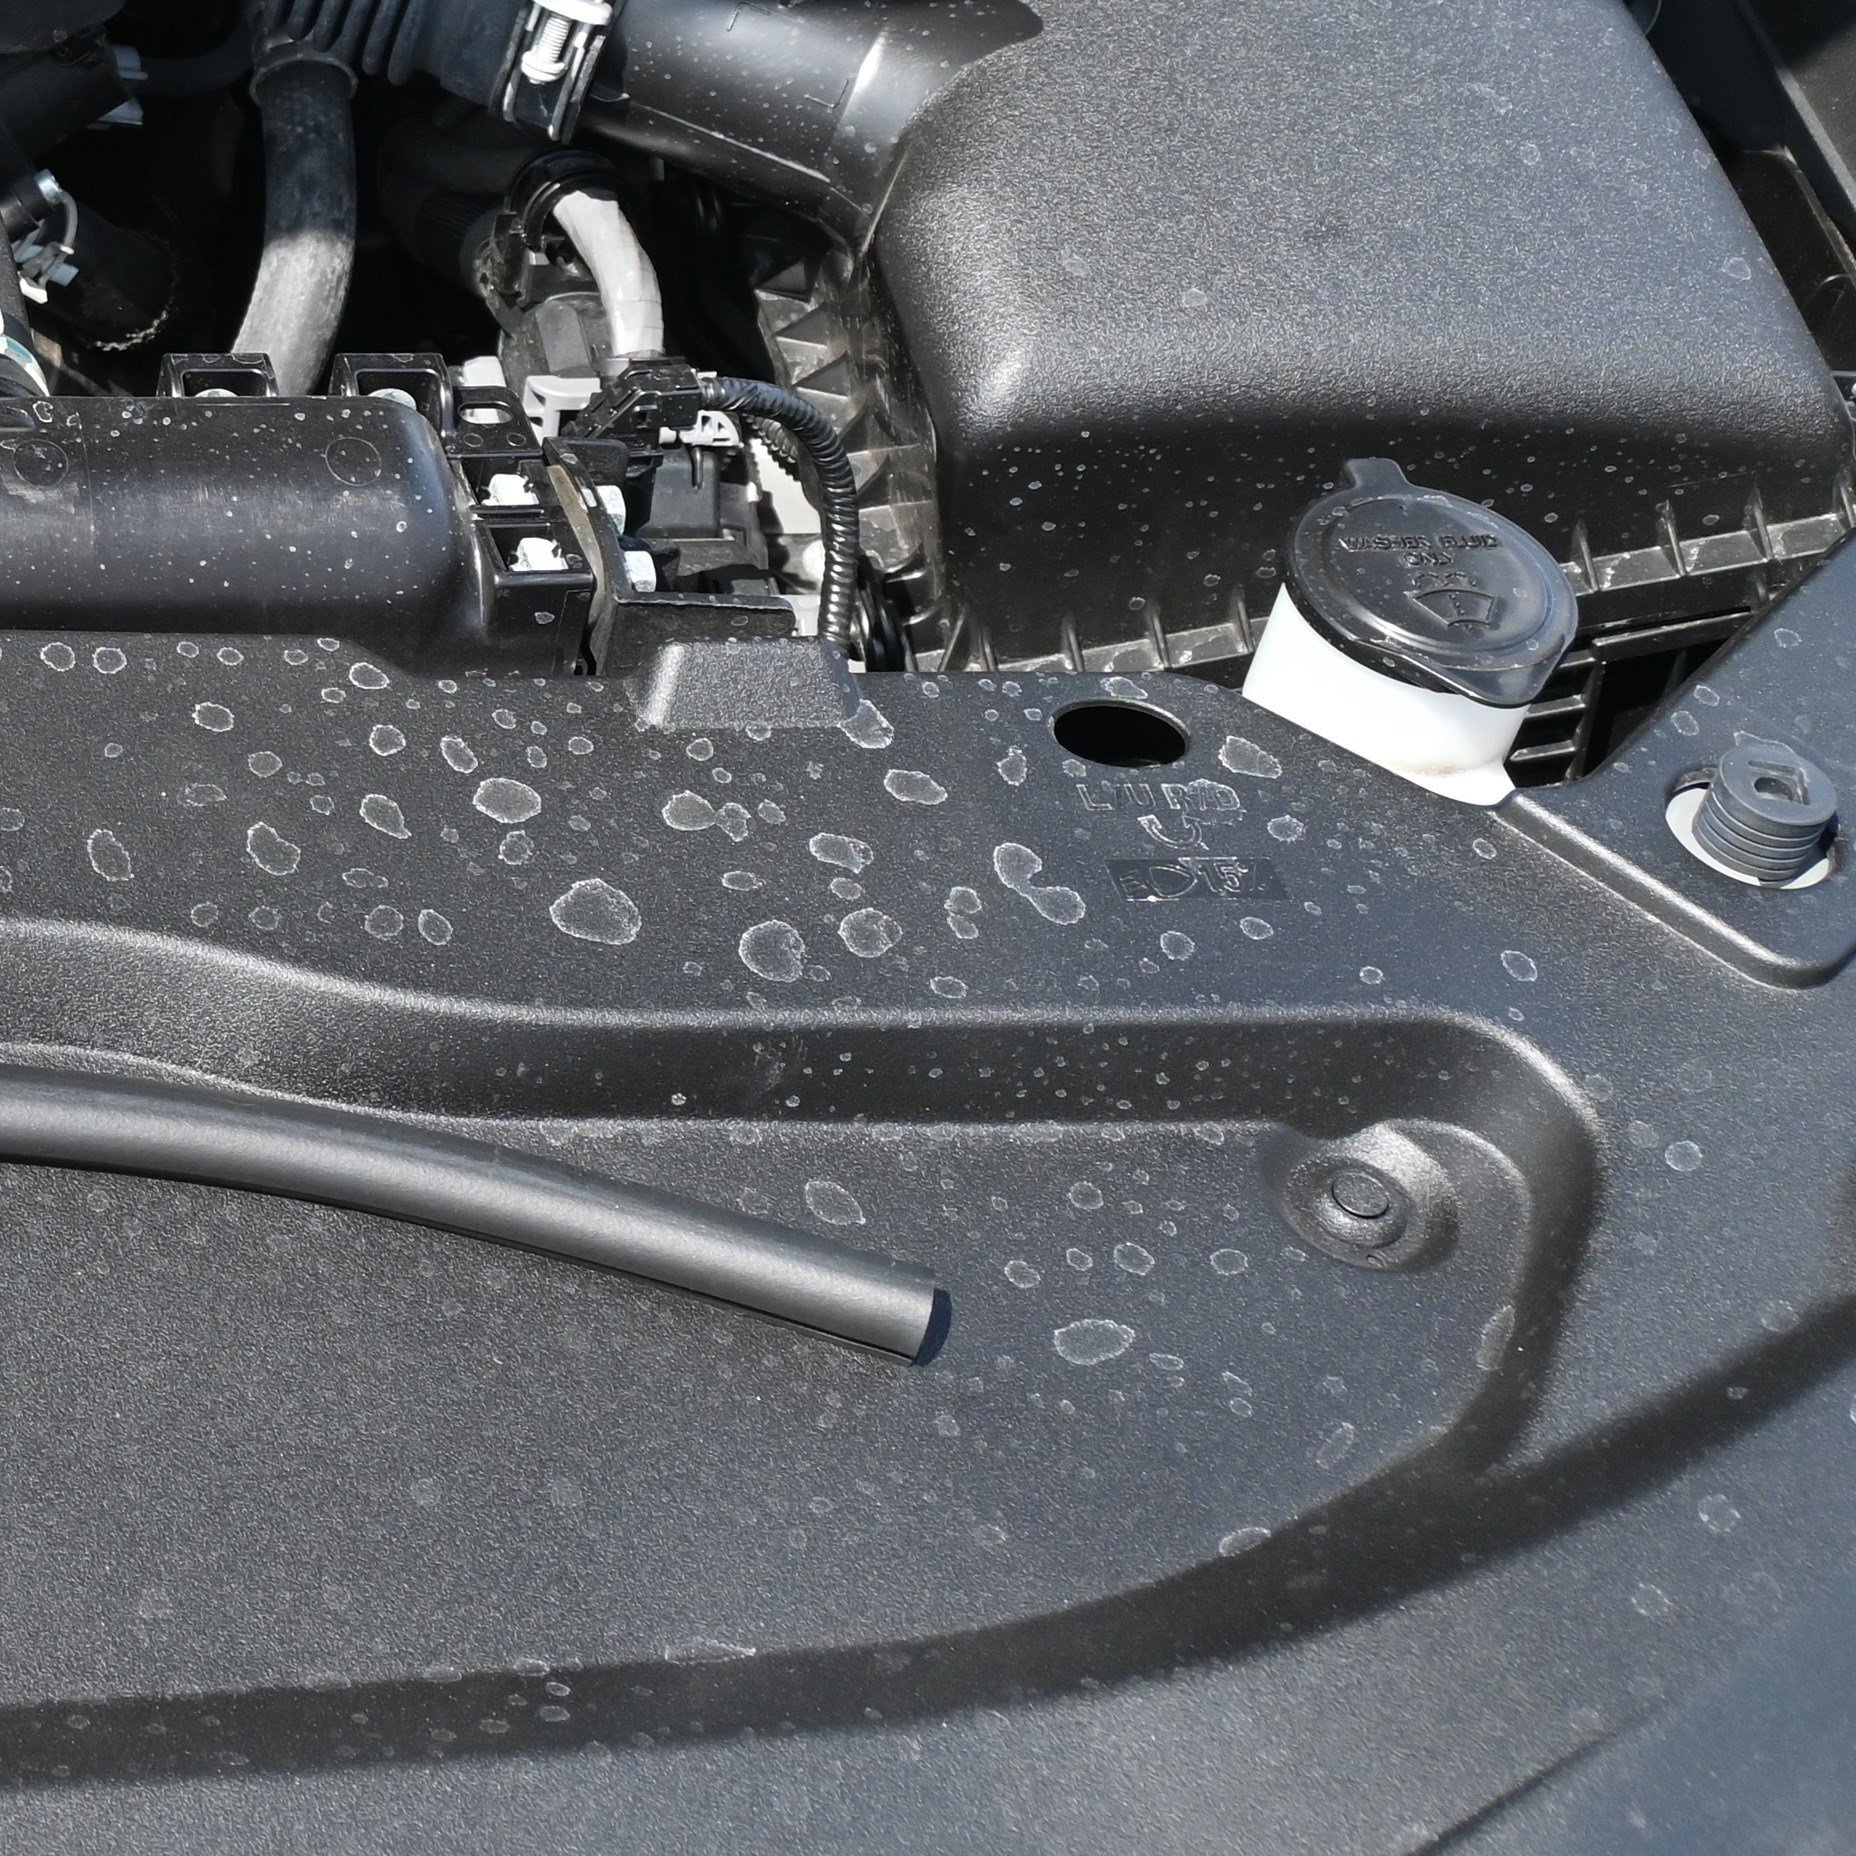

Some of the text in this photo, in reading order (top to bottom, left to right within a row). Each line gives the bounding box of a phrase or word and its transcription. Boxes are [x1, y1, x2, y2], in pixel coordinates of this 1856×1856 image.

[1337, 532, 1500, 553] WASHER FLUID
[1402, 550, 1456, 568] ONLY
